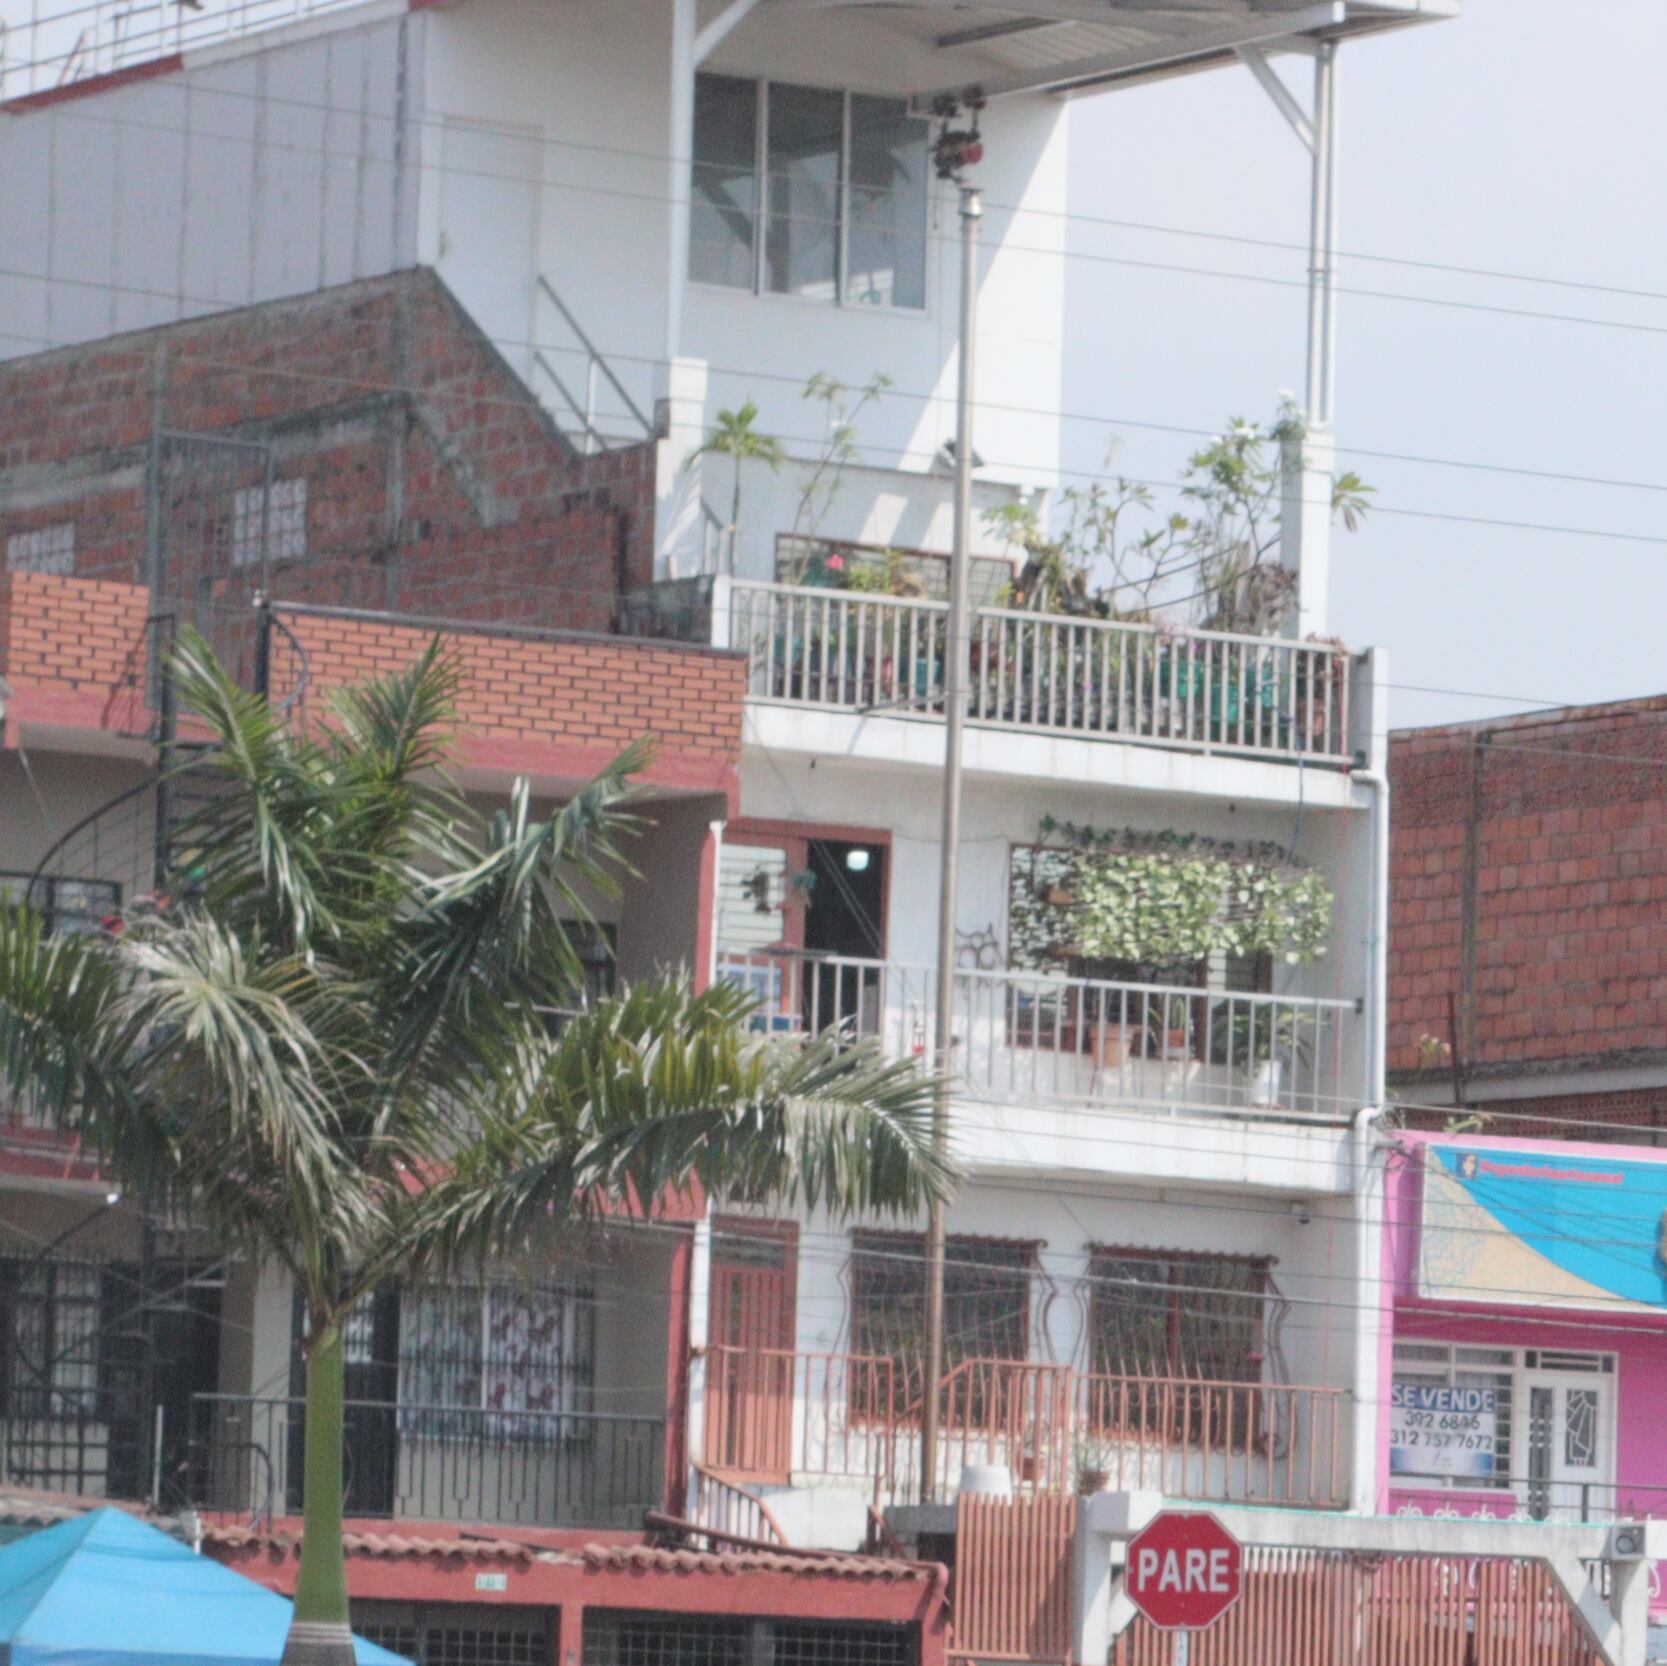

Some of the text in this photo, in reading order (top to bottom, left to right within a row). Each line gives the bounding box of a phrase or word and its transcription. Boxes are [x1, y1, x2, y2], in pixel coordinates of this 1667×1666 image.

[1391, 1385, 1494, 1412] SE VENDE
[1404, 1410, 1434, 1428] 392
[1390, 1429, 1419, 1446] 312
[1137, 1547, 1230, 1592] PARE
